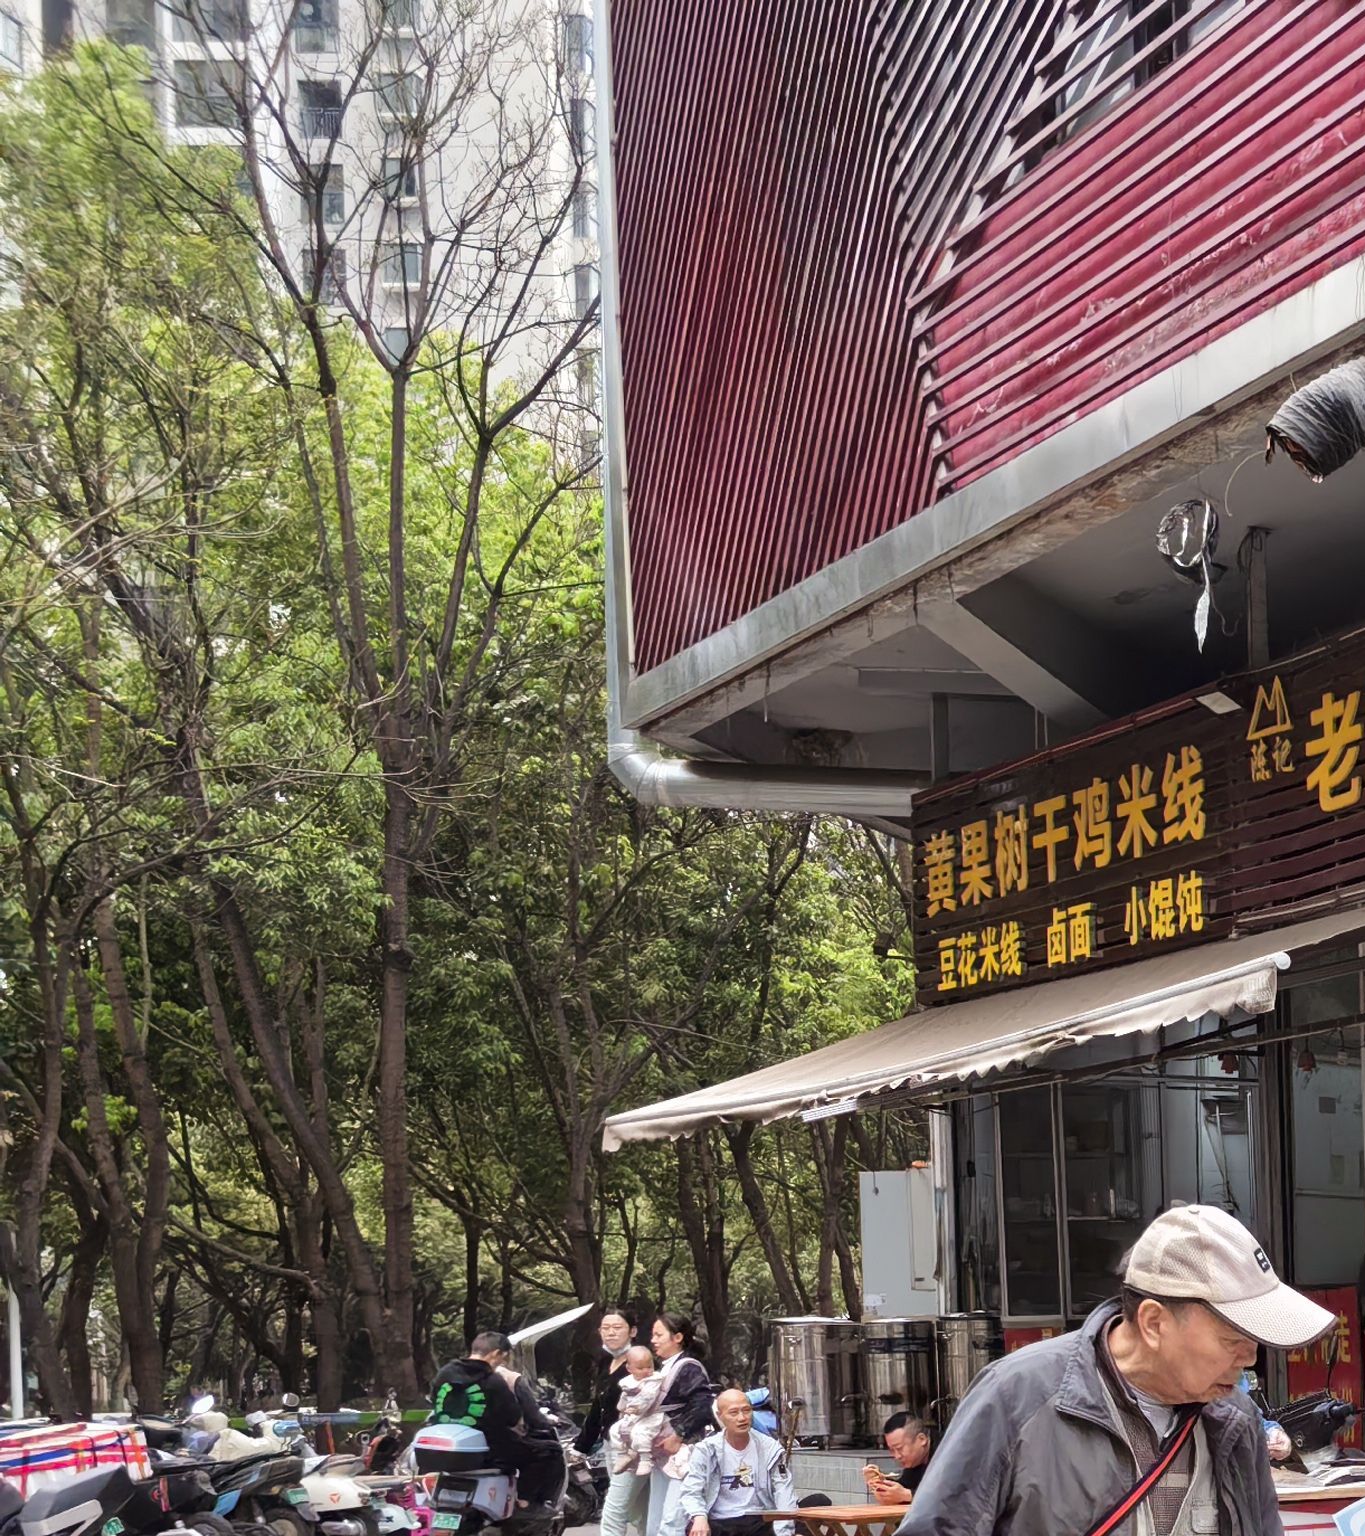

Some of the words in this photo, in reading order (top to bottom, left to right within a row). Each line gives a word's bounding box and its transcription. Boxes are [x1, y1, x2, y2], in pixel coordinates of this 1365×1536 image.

[925, 746, 1208, 917] 黄果树干鸡米线
[1047, 903, 1094, 967] 卤面
[1125, 871, 1205, 946] 小馄饨
[938, 920, 1022, 991] 豆花米线
